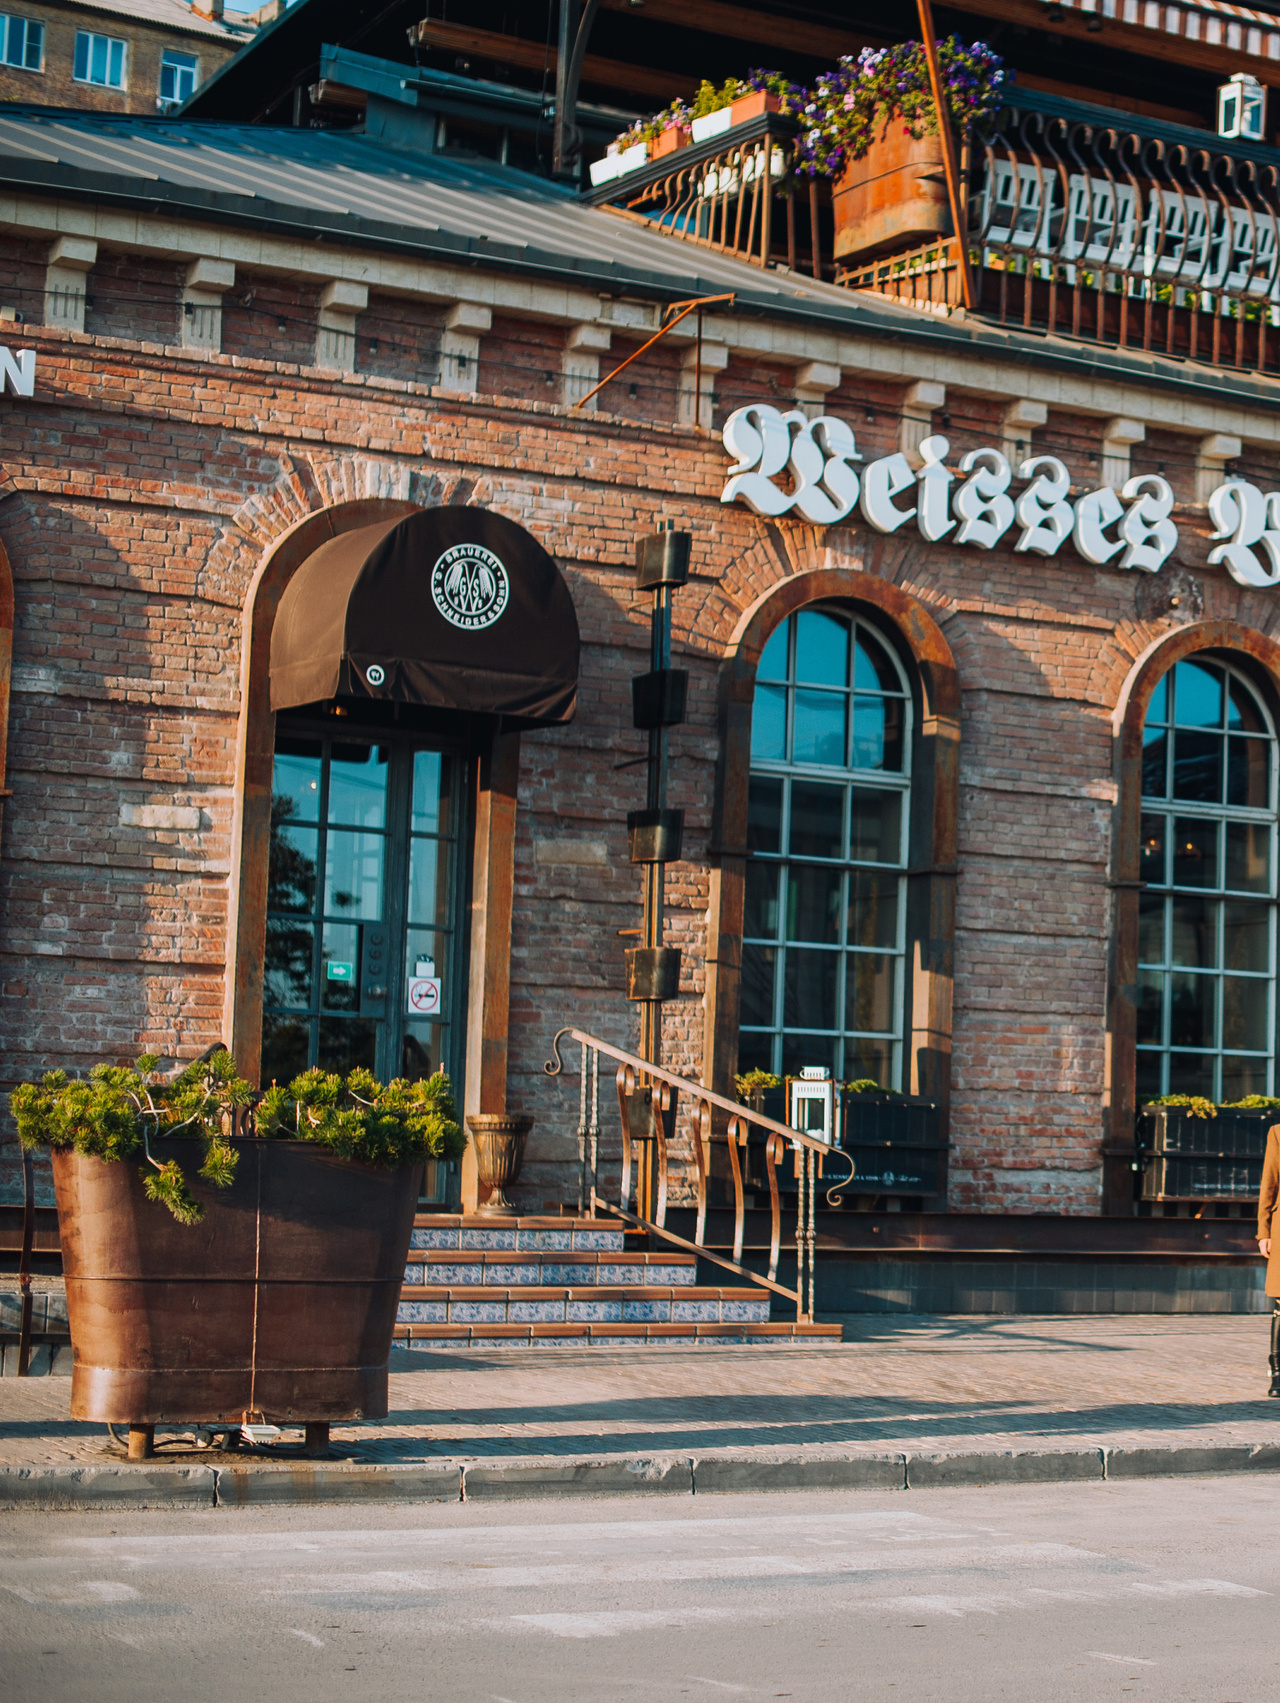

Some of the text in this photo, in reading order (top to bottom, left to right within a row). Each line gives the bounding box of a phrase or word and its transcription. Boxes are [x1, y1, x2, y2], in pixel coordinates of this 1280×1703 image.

[0, 346, 36, 397] N
[720, 403, 1178, 573] Weisses
[445, 547, 498, 570] BRAUEREI
